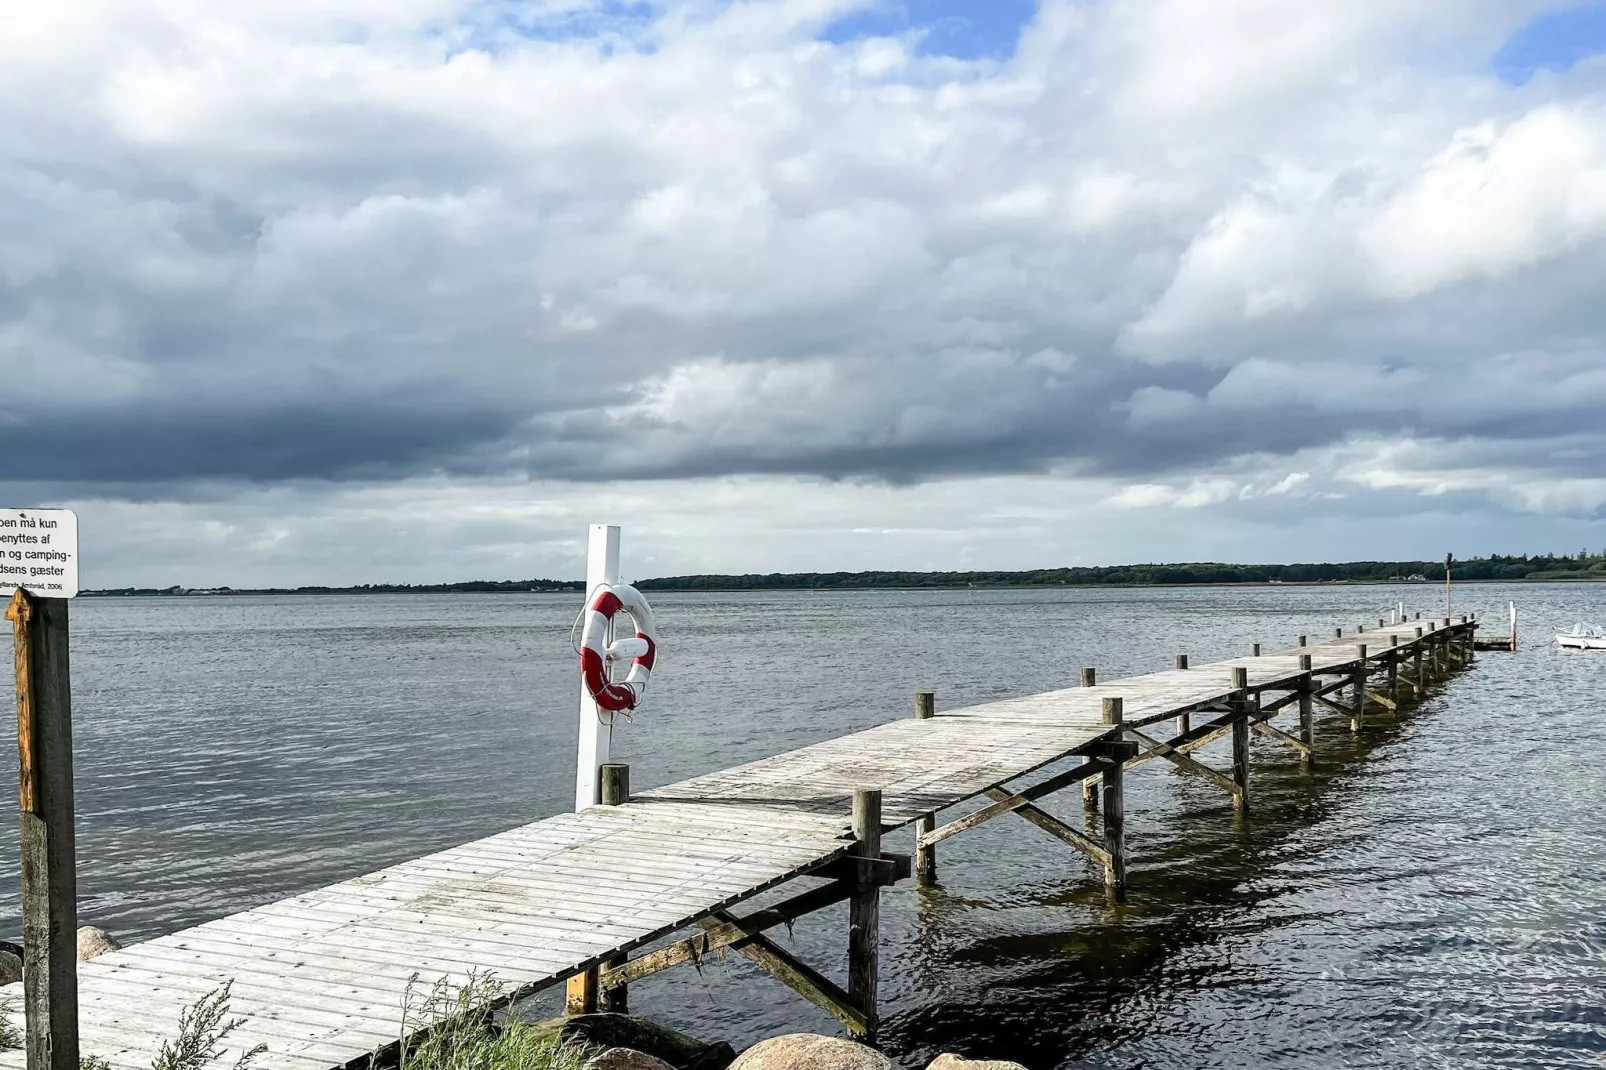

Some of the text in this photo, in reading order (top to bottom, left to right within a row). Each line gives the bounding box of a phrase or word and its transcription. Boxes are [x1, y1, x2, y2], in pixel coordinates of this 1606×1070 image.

[20, 517, 36, 528] må
[39, 518, 57, 528] kun
[0, 533, 50, 545] enyttes af
[8, 550, 22, 561] og
[24, 549, 72, 562] camping-
[30, 565, 65, 576] gæster
